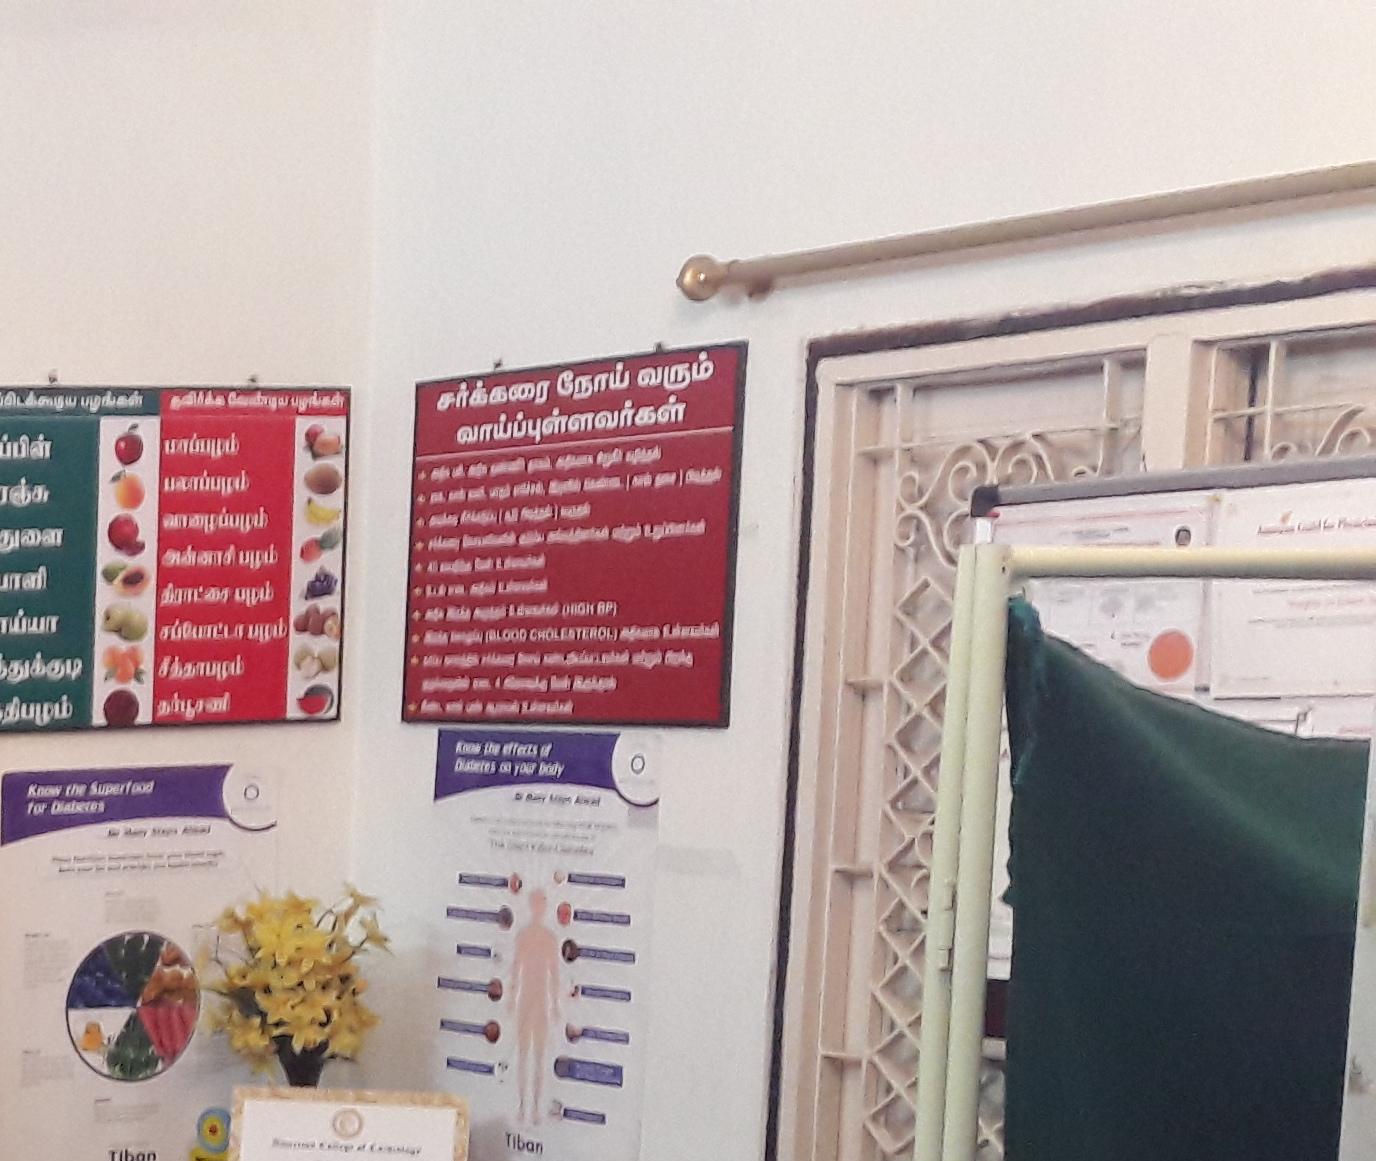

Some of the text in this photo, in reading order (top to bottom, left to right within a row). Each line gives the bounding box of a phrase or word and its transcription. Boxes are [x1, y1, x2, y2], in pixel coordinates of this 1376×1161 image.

[436, 350, 715, 412] சர்க்கரை நோய் வரும்
[80, 390, 144, 413] பழங்கள்
[456, 394, 687, 445] வாய்ப்புள்ளவர்கள்
[239, 544, 278, 569] பழம்
[234, 581, 274, 607] பழம்
[247, 617, 288, 643] பழம்
[28, 780, 156, 798] Know the Superfood
[27, 801, 47, 815] for
[505, 1132, 544, 1155] Tiban
